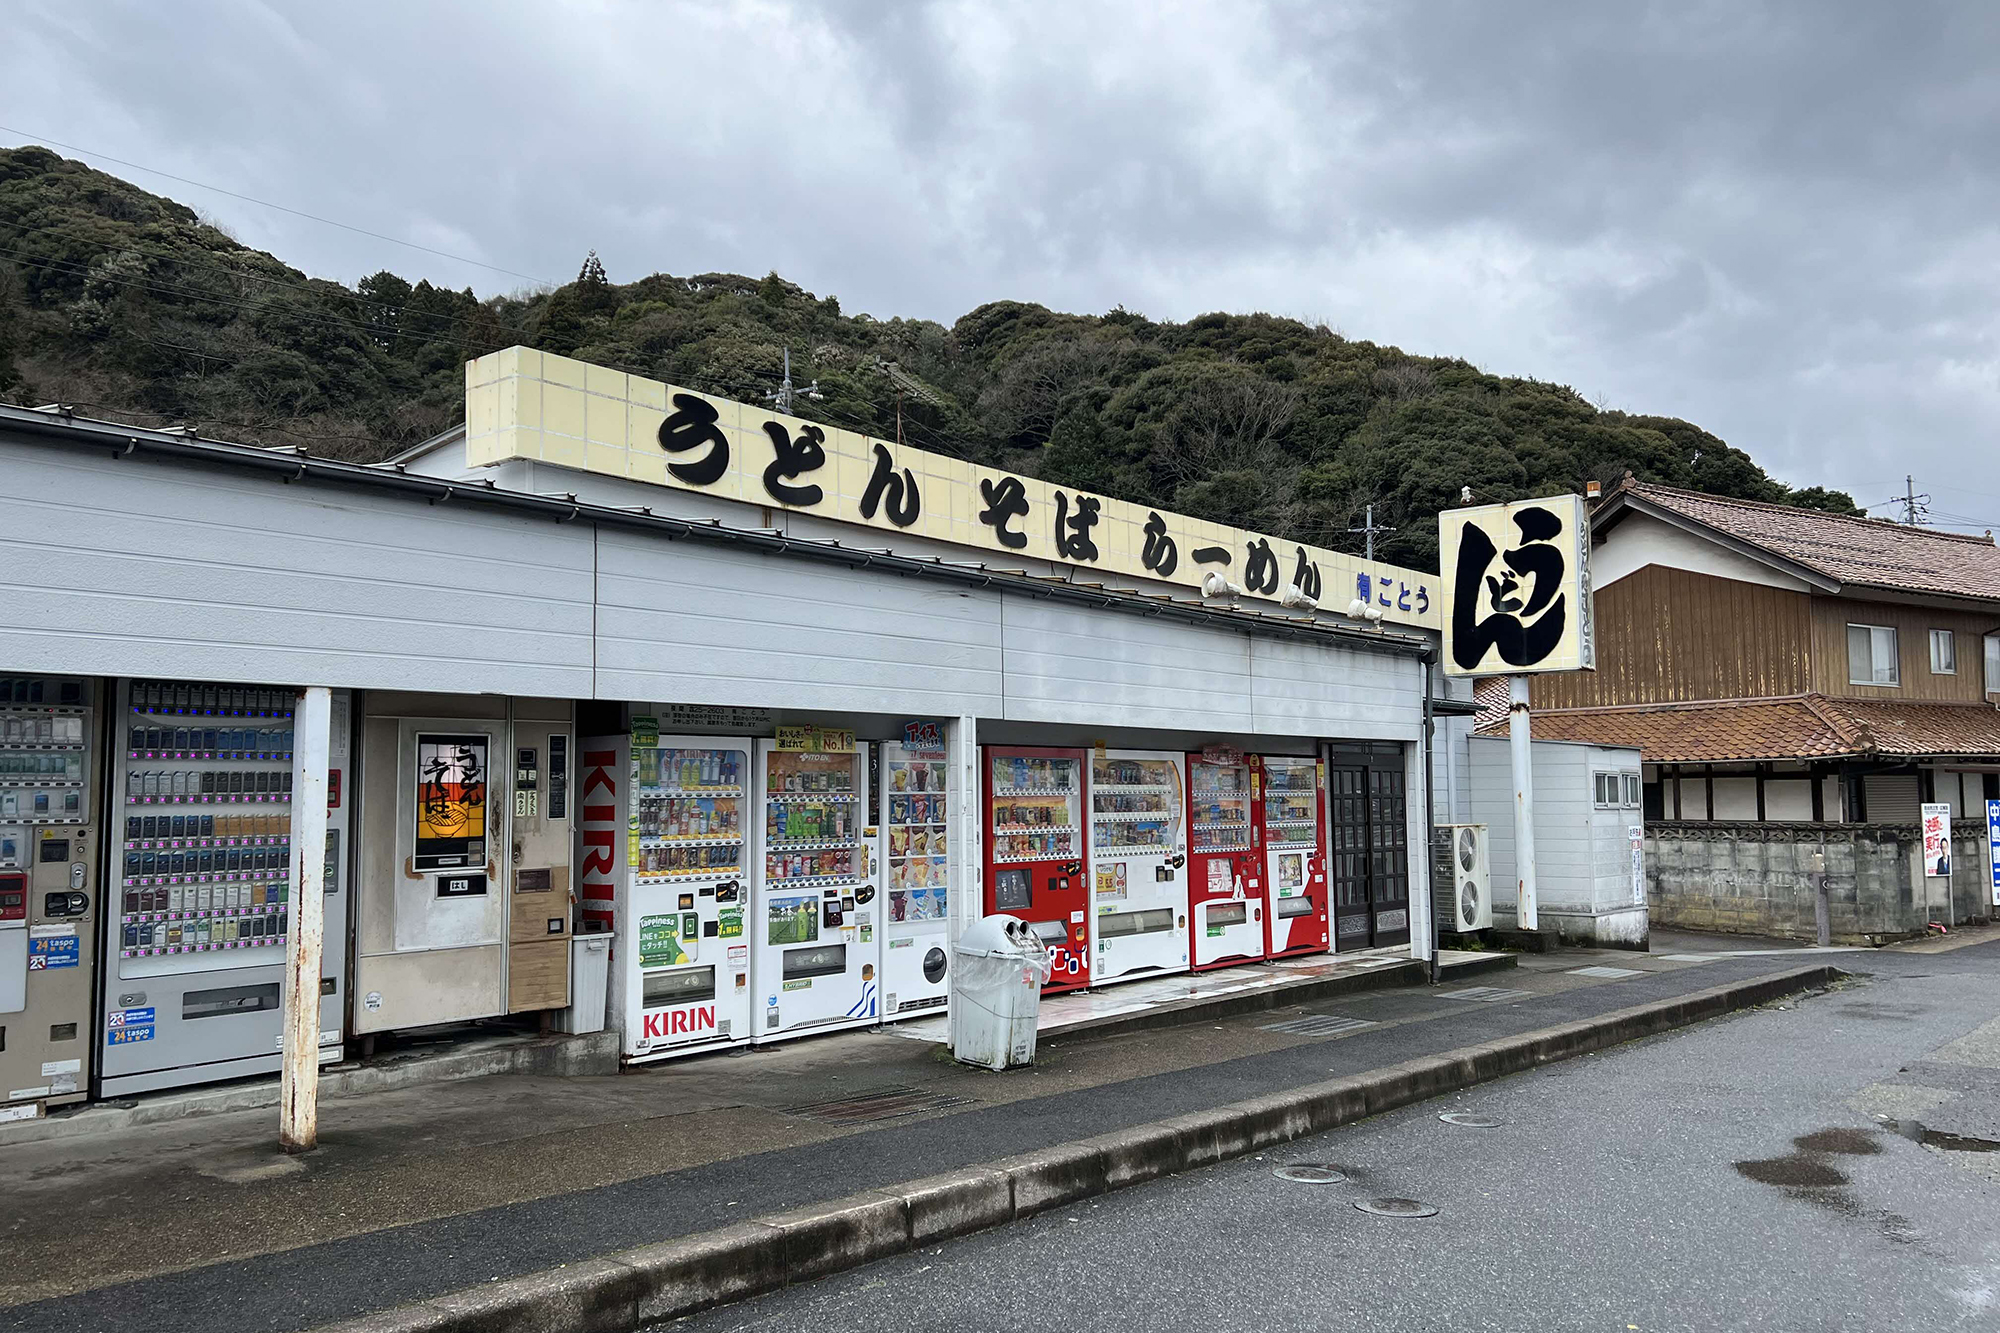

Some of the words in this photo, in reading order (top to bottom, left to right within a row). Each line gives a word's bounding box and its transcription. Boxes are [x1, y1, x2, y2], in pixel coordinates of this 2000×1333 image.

[658, 394, 920, 527] うどん
[979, 472, 1100, 563] そば
[1141, 511, 1322, 601] らーめん
[905, 721, 938, 743] アイス
[823, 731, 845, 751] No.1
[451, 880, 466, 890] はし
[640, 916, 675, 928] Tappiness
[49, 939, 74, 948] taspo
[643, 1005, 715, 1039] KIRIN
[126, 1029, 150, 1037] taspo
